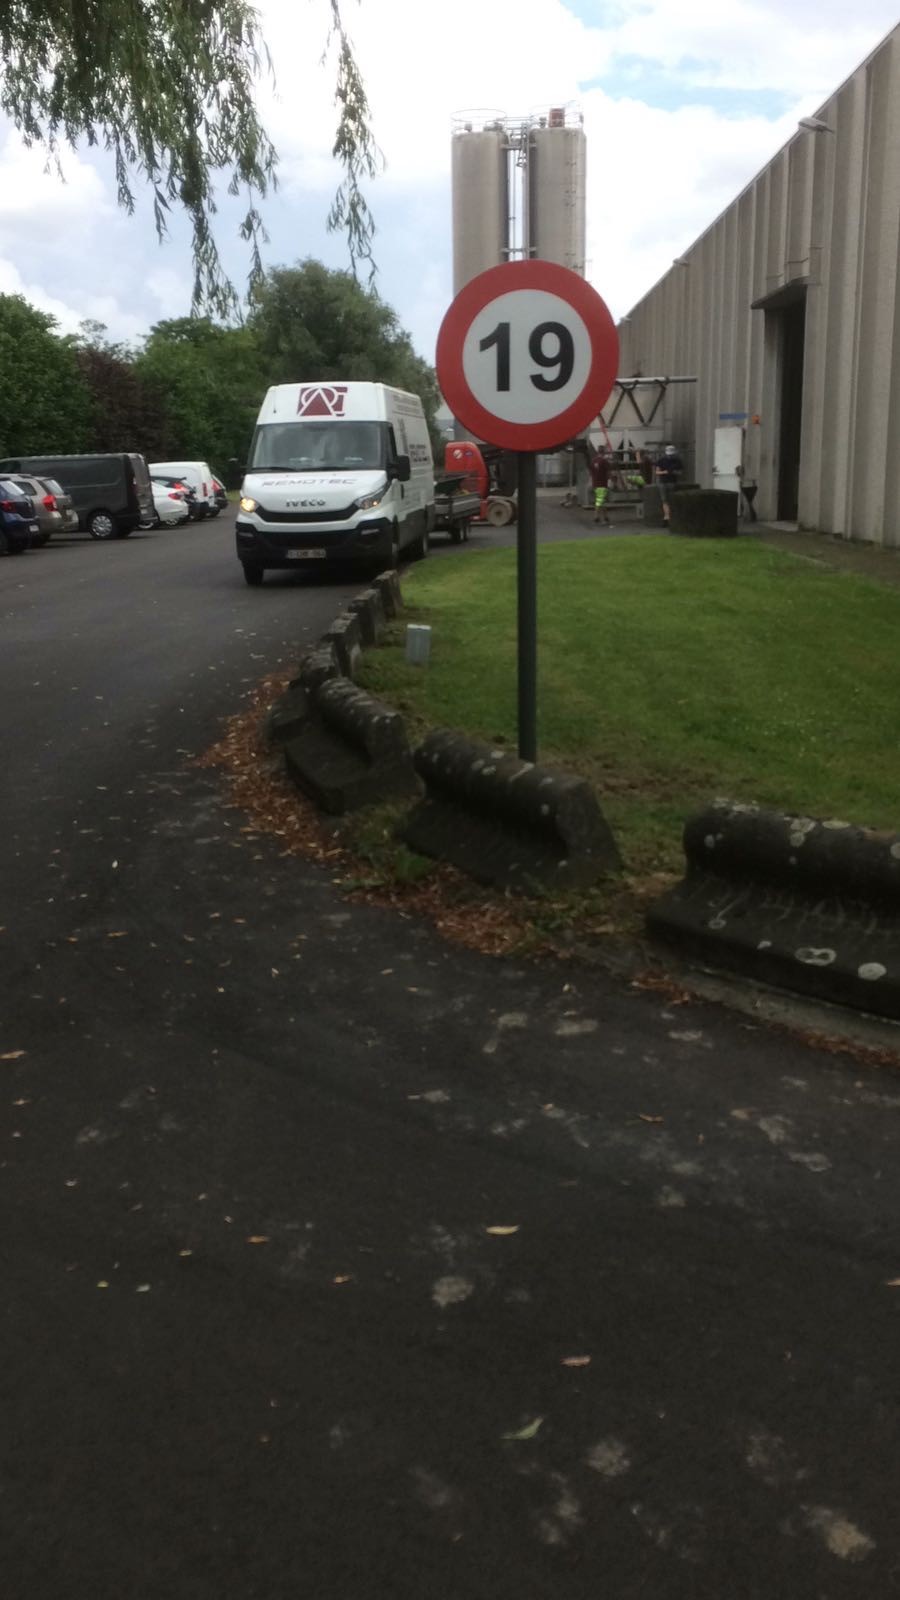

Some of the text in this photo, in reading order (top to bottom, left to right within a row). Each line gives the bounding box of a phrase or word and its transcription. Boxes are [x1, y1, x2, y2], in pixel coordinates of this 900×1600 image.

[479, 321, 575, 392] 19
[262, 479, 357, 487] REMOTEC
[286, 499, 326, 507] IVECO
